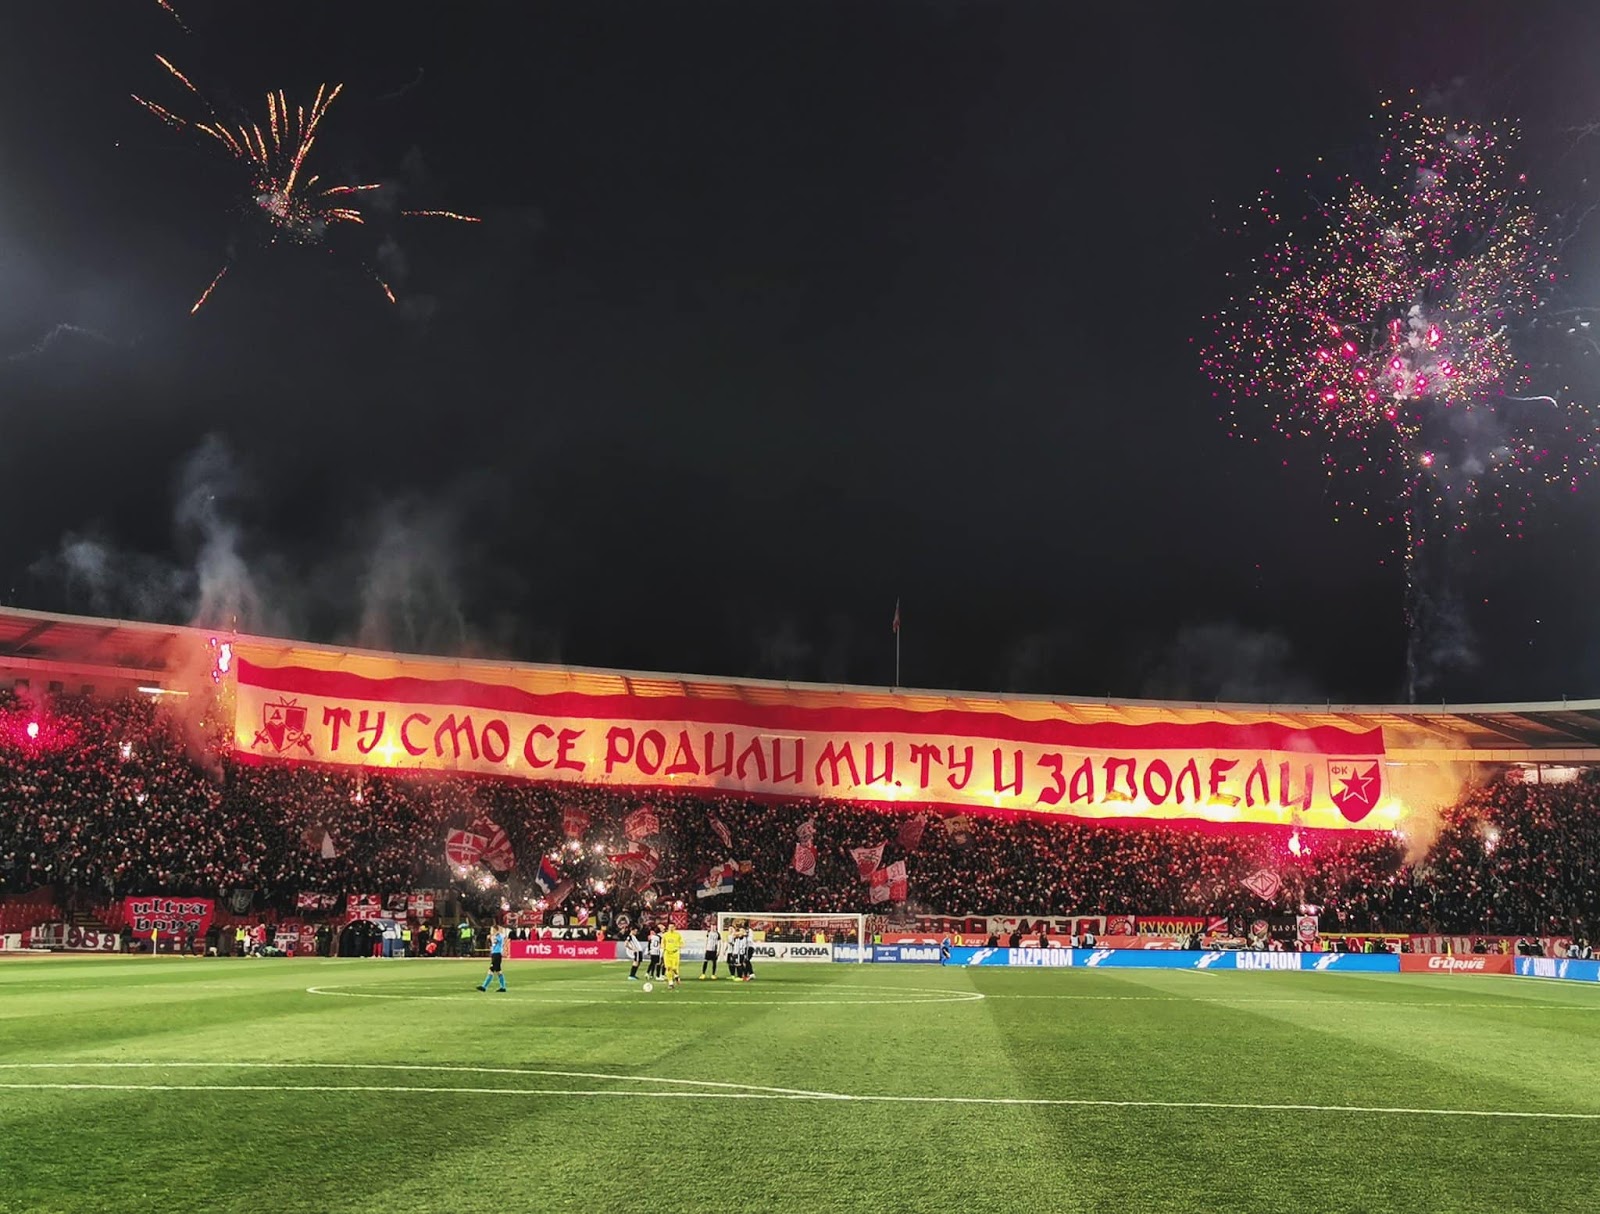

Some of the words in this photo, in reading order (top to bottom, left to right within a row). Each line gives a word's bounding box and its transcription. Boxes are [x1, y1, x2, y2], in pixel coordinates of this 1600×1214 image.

[322, 706, 385, 754] ТУ
[400, 712, 511, 763] СМО
[523, 724, 586, 773] СЕ
[605, 725, 805, 785] РОДИЛИ
[909, 743, 974, 790] ТУ
[993, 748, 1024, 798] И
[1330, 764, 1348, 776] ФК
[131, 898, 207, 916] ultra
[133, 915, 201, 935] boys
[526, 943, 552, 955] mts
[557, 945, 576, 957] Tvoj
[578, 946, 599, 955] svet
[790, 946, 829, 956] ROMA
[900, 947, 940, 960] M&M
[1008, 948, 1072, 966] GAZPROM
[1235, 951, 1302, 971] GAZPROM
